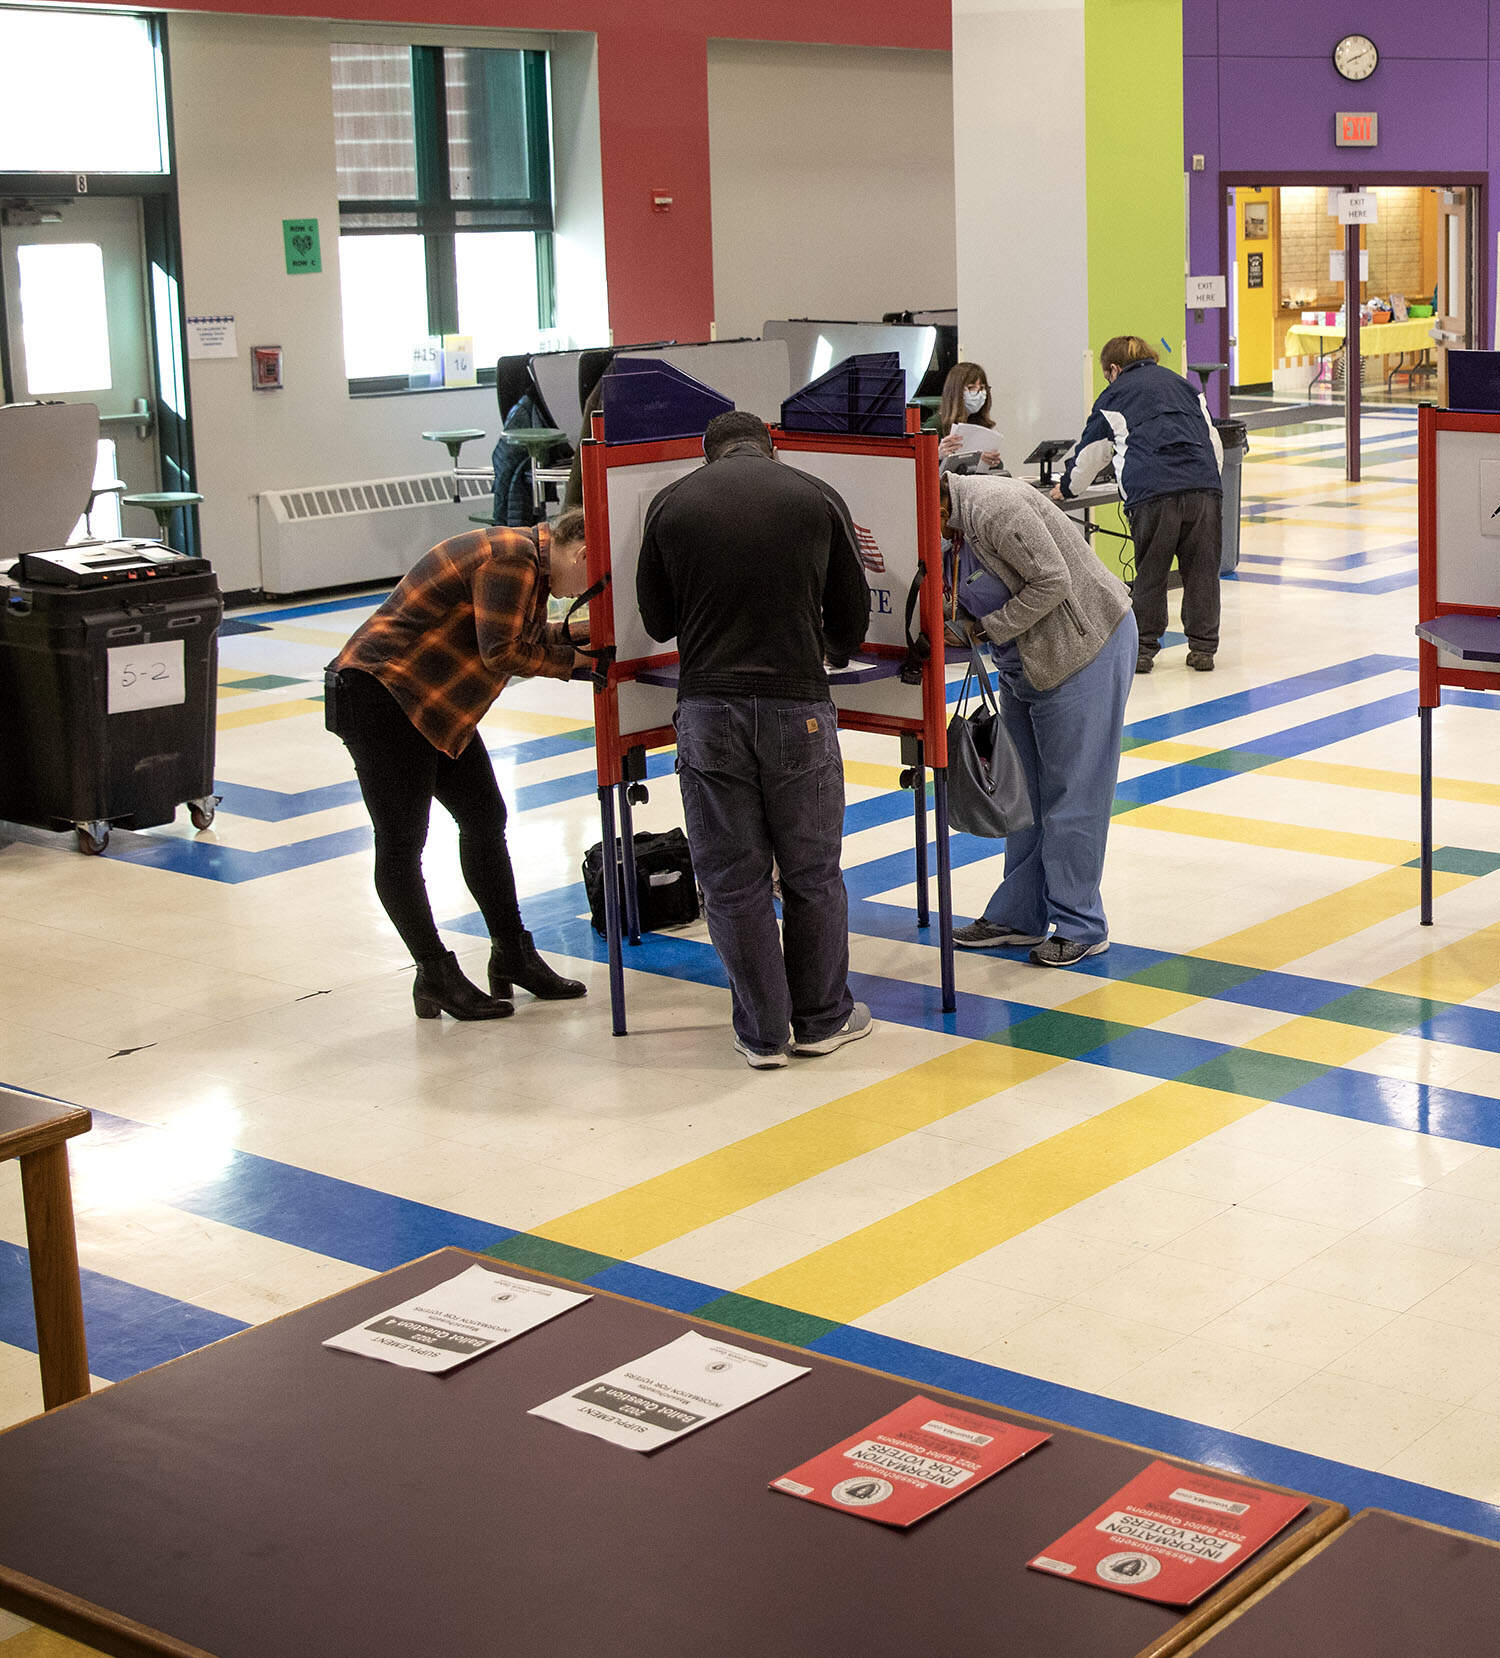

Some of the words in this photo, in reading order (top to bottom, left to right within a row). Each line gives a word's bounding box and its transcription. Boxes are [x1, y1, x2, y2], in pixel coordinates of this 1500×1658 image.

[1342, 116, 1372, 141] EXIT
[78, 175, 86, 192] 8
[1197, 282, 1213, 290] EXIT
[1196, 293, 1216, 302] HERE
[413, 348, 437, 361] #15
[868, 589, 893, 614] TE
[121, 662, 169, 687] 5-2
[385, 1318, 397, 1326] 4
[397, 1319, 449, 1340] Question
[370, 1336, 441, 1358] SUPPLEMENT
[411, 1334, 437, 1344] 2022
[450, 1331, 487, 1347] Ballot
[594, 1385, 606, 1394] 4
[670, 1388, 722, 1408] INFORMATION
[609, 1388, 658, 1412] Question
[577, 1406, 648, 1434] SUPPLEMENT
[618, 1404, 645, 1418] 2022
[659, 1405, 696, 1424] Ballot
[876, 1434, 926, 1454] Questions
[867, 1443, 928, 1466] VOTERS
[925, 1448, 957, 1462] Ballot
[958, 1458, 982, 1470] 2022
[853, 1451, 954, 1486] INFORMATION
[853, 1461, 928, 1489] Massachusetts
[928, 1458, 962, 1476] FOR
[1126, 1504, 1182, 1527] Questions
[1120, 1515, 1191, 1540] VOTERS
[1183, 1521, 1218, 1534] Ballot
[1221, 1530, 1246, 1542] 2022
[1105, 1522, 1222, 1560] INFORMATION
[1109, 1535, 1196, 1564] Massachusetts
[1191, 1532, 1228, 1550] FOR
